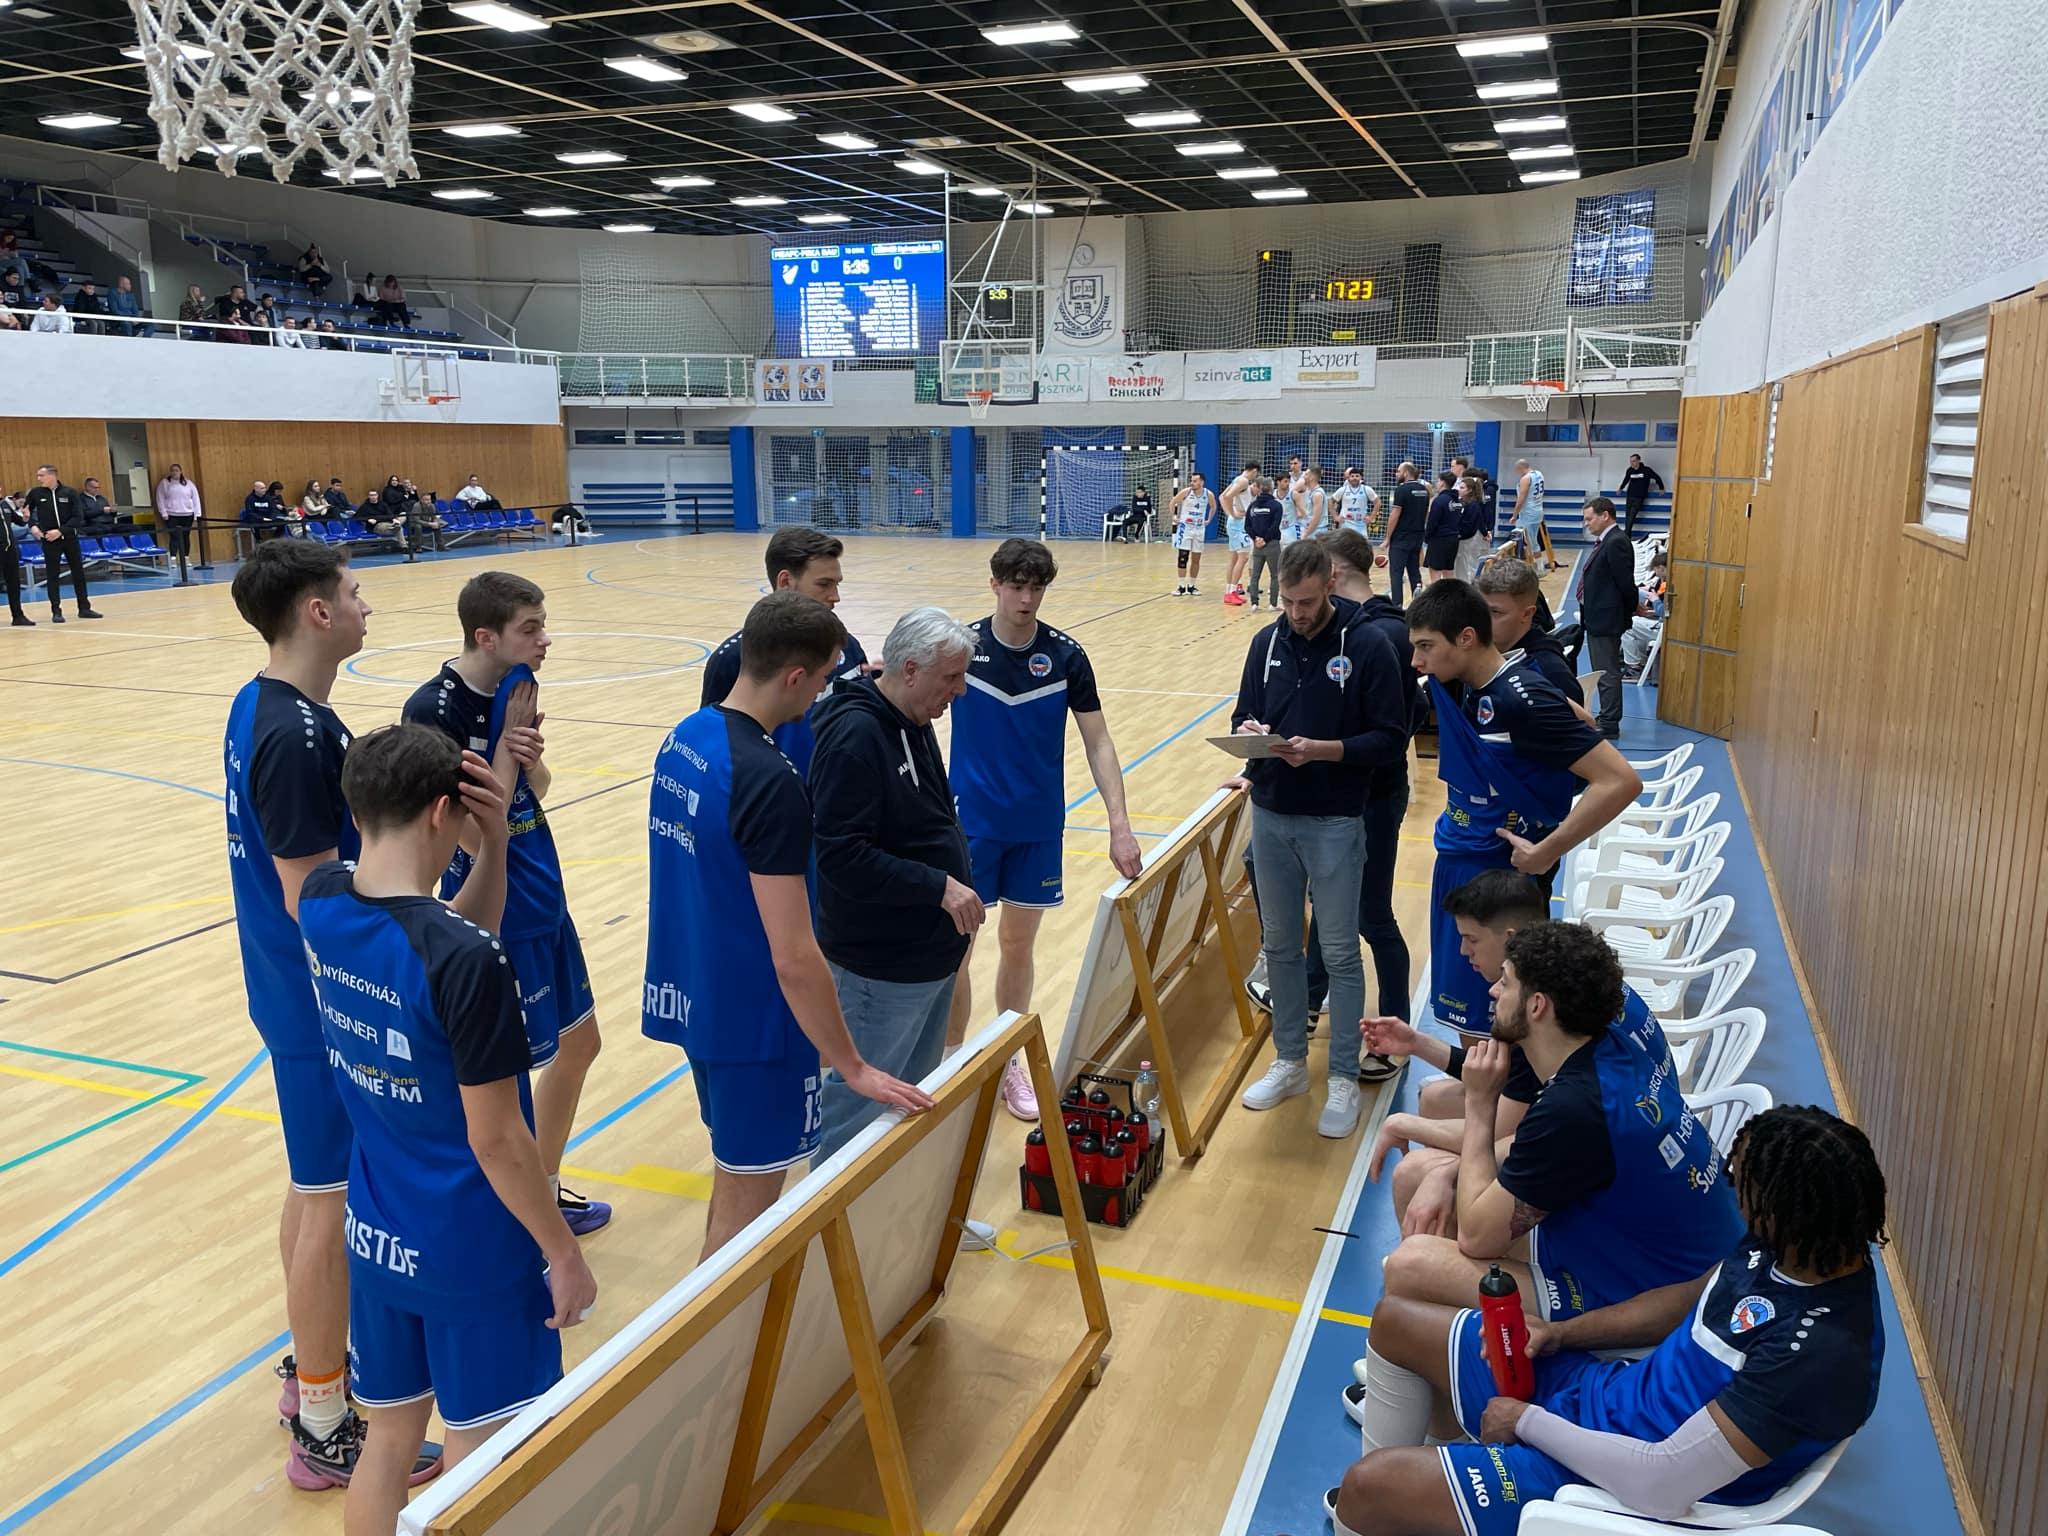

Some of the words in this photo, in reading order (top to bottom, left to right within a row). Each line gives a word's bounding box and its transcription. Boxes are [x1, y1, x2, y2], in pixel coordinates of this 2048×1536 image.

[1299, 349, 1360, 371] Expert
[1194, 368, 1265, 382] szinvanet
[1533, 480, 1545, 496] 33
[643, 981, 691, 1028] RÖLY
[1546, 1278, 1561, 1310] JAKO
[1467, 1466, 1490, 1507] JAKO
